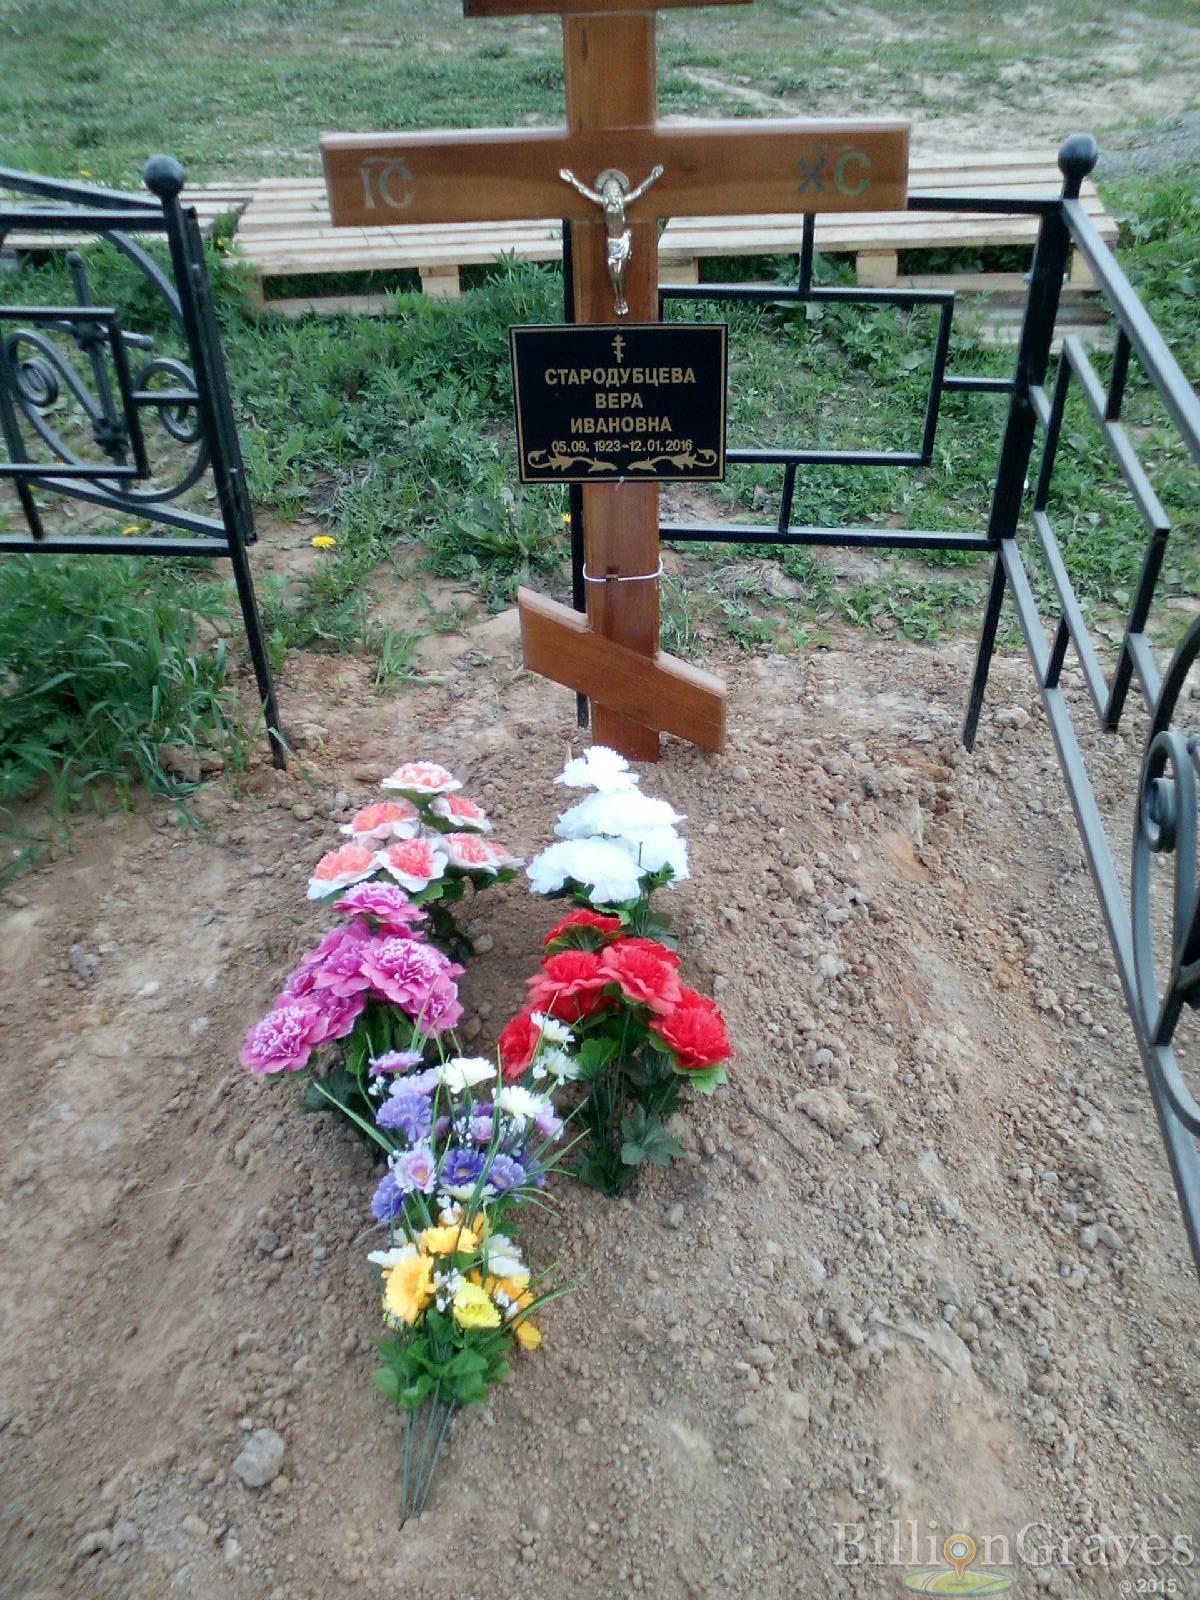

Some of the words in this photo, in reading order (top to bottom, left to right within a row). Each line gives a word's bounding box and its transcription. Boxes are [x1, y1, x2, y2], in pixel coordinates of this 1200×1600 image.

[544, 367, 697, 388] СТАРОДУБЦЕВА
[595, 393, 644, 409] ВЕРА
[570, 416, 673, 434] ИВАНОВНА
